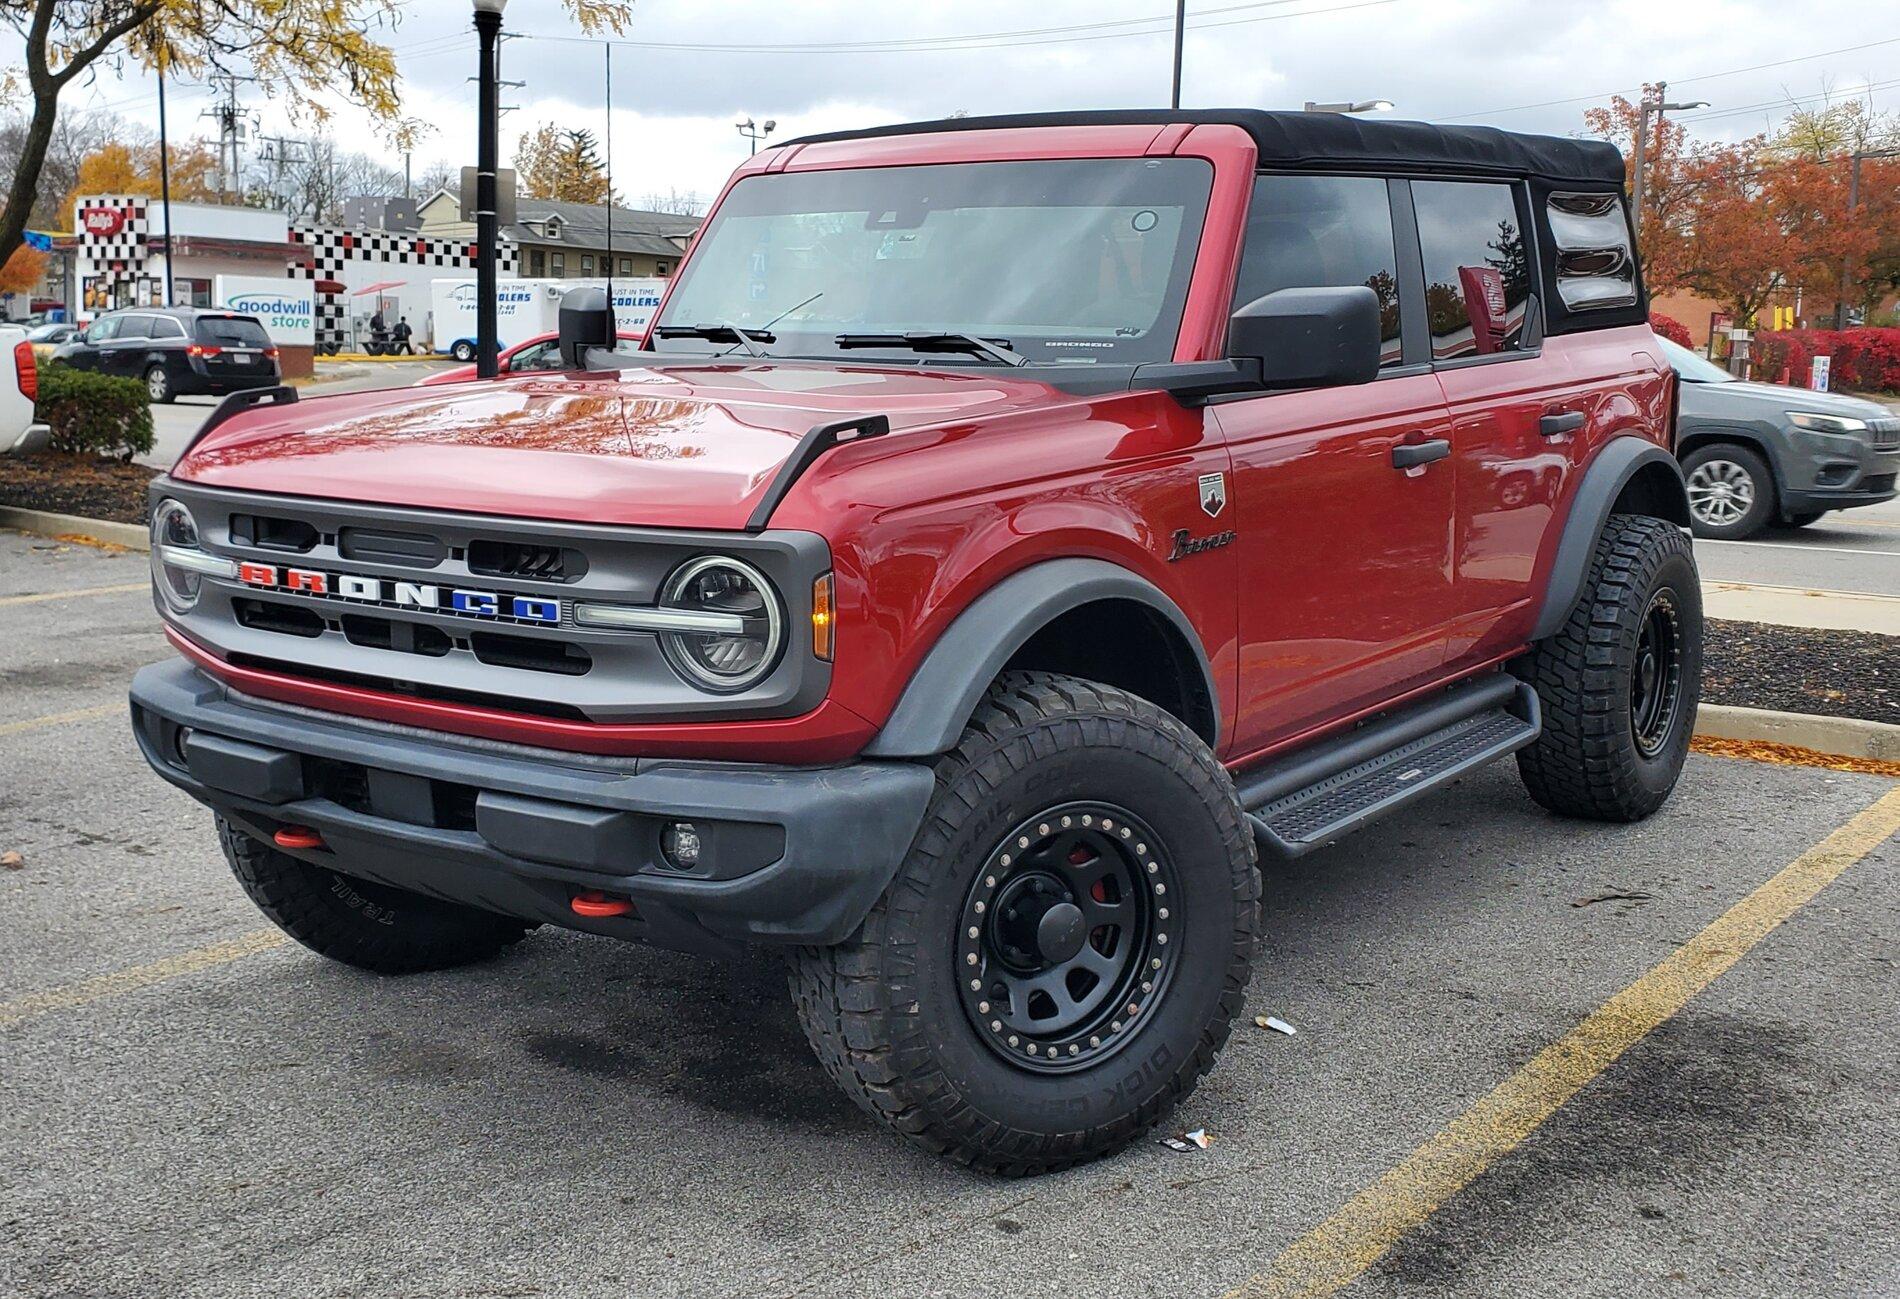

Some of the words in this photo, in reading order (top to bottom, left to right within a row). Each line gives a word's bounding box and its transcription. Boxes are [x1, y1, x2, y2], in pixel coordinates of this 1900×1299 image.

[498, 293, 531, 301] OLERS
[611, 297, 660, 306] COOLERS
[238, 299, 310, 314] goodwill
[271, 315, 310, 328] store
[1045, 340, 1114, 348] BRONCO
[239, 561, 561, 623] BRONCO
[331, 875, 394, 926] TRAIL
[1103, 1043, 1173, 1108] DICK
